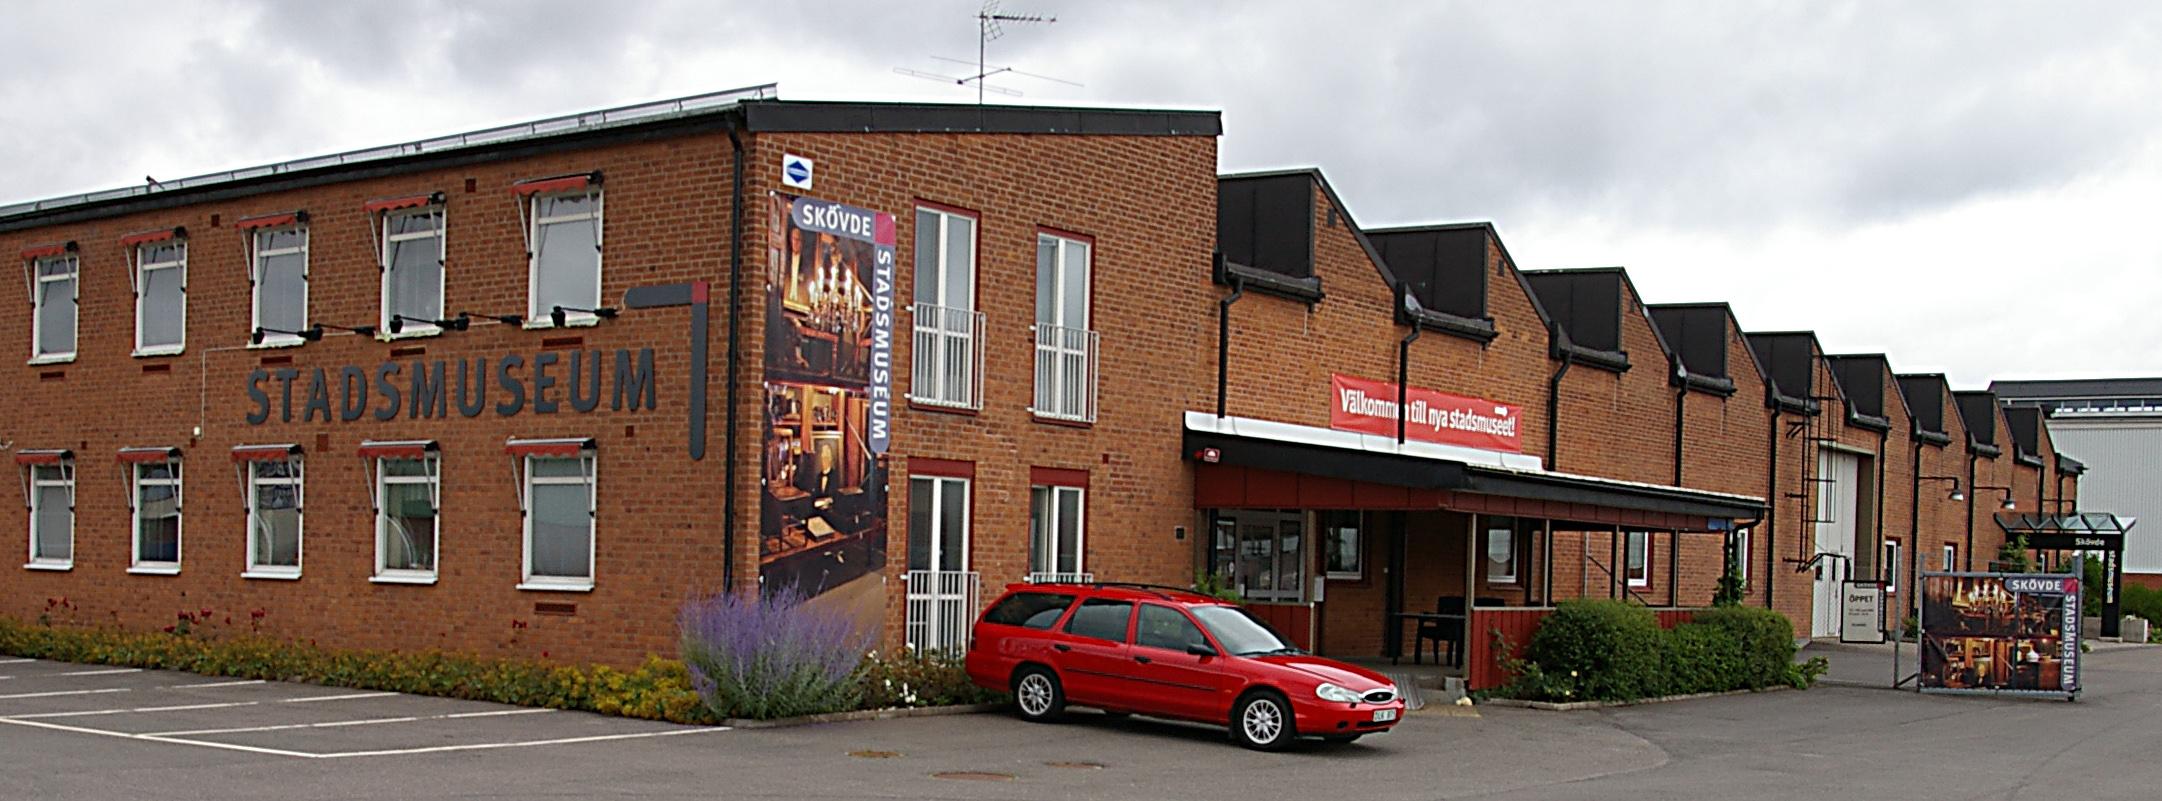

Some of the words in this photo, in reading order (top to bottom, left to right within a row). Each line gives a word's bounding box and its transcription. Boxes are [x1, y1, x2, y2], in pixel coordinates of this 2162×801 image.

[802, 204, 872, 237] SKÖVDE
[872, 249, 892, 440] STADSMUSEUM
[246, 347, 657, 427] STADSMUSEUM
[1410, 400, 1427, 424] till
[1428, 409, 1448, 432] nya
[1449, 408, 1516, 438] stadsmuseet!
[2011, 578, 2062, 592] SKÖVDE
[2063, 594, 2077, 685] STADSMUSEUM
